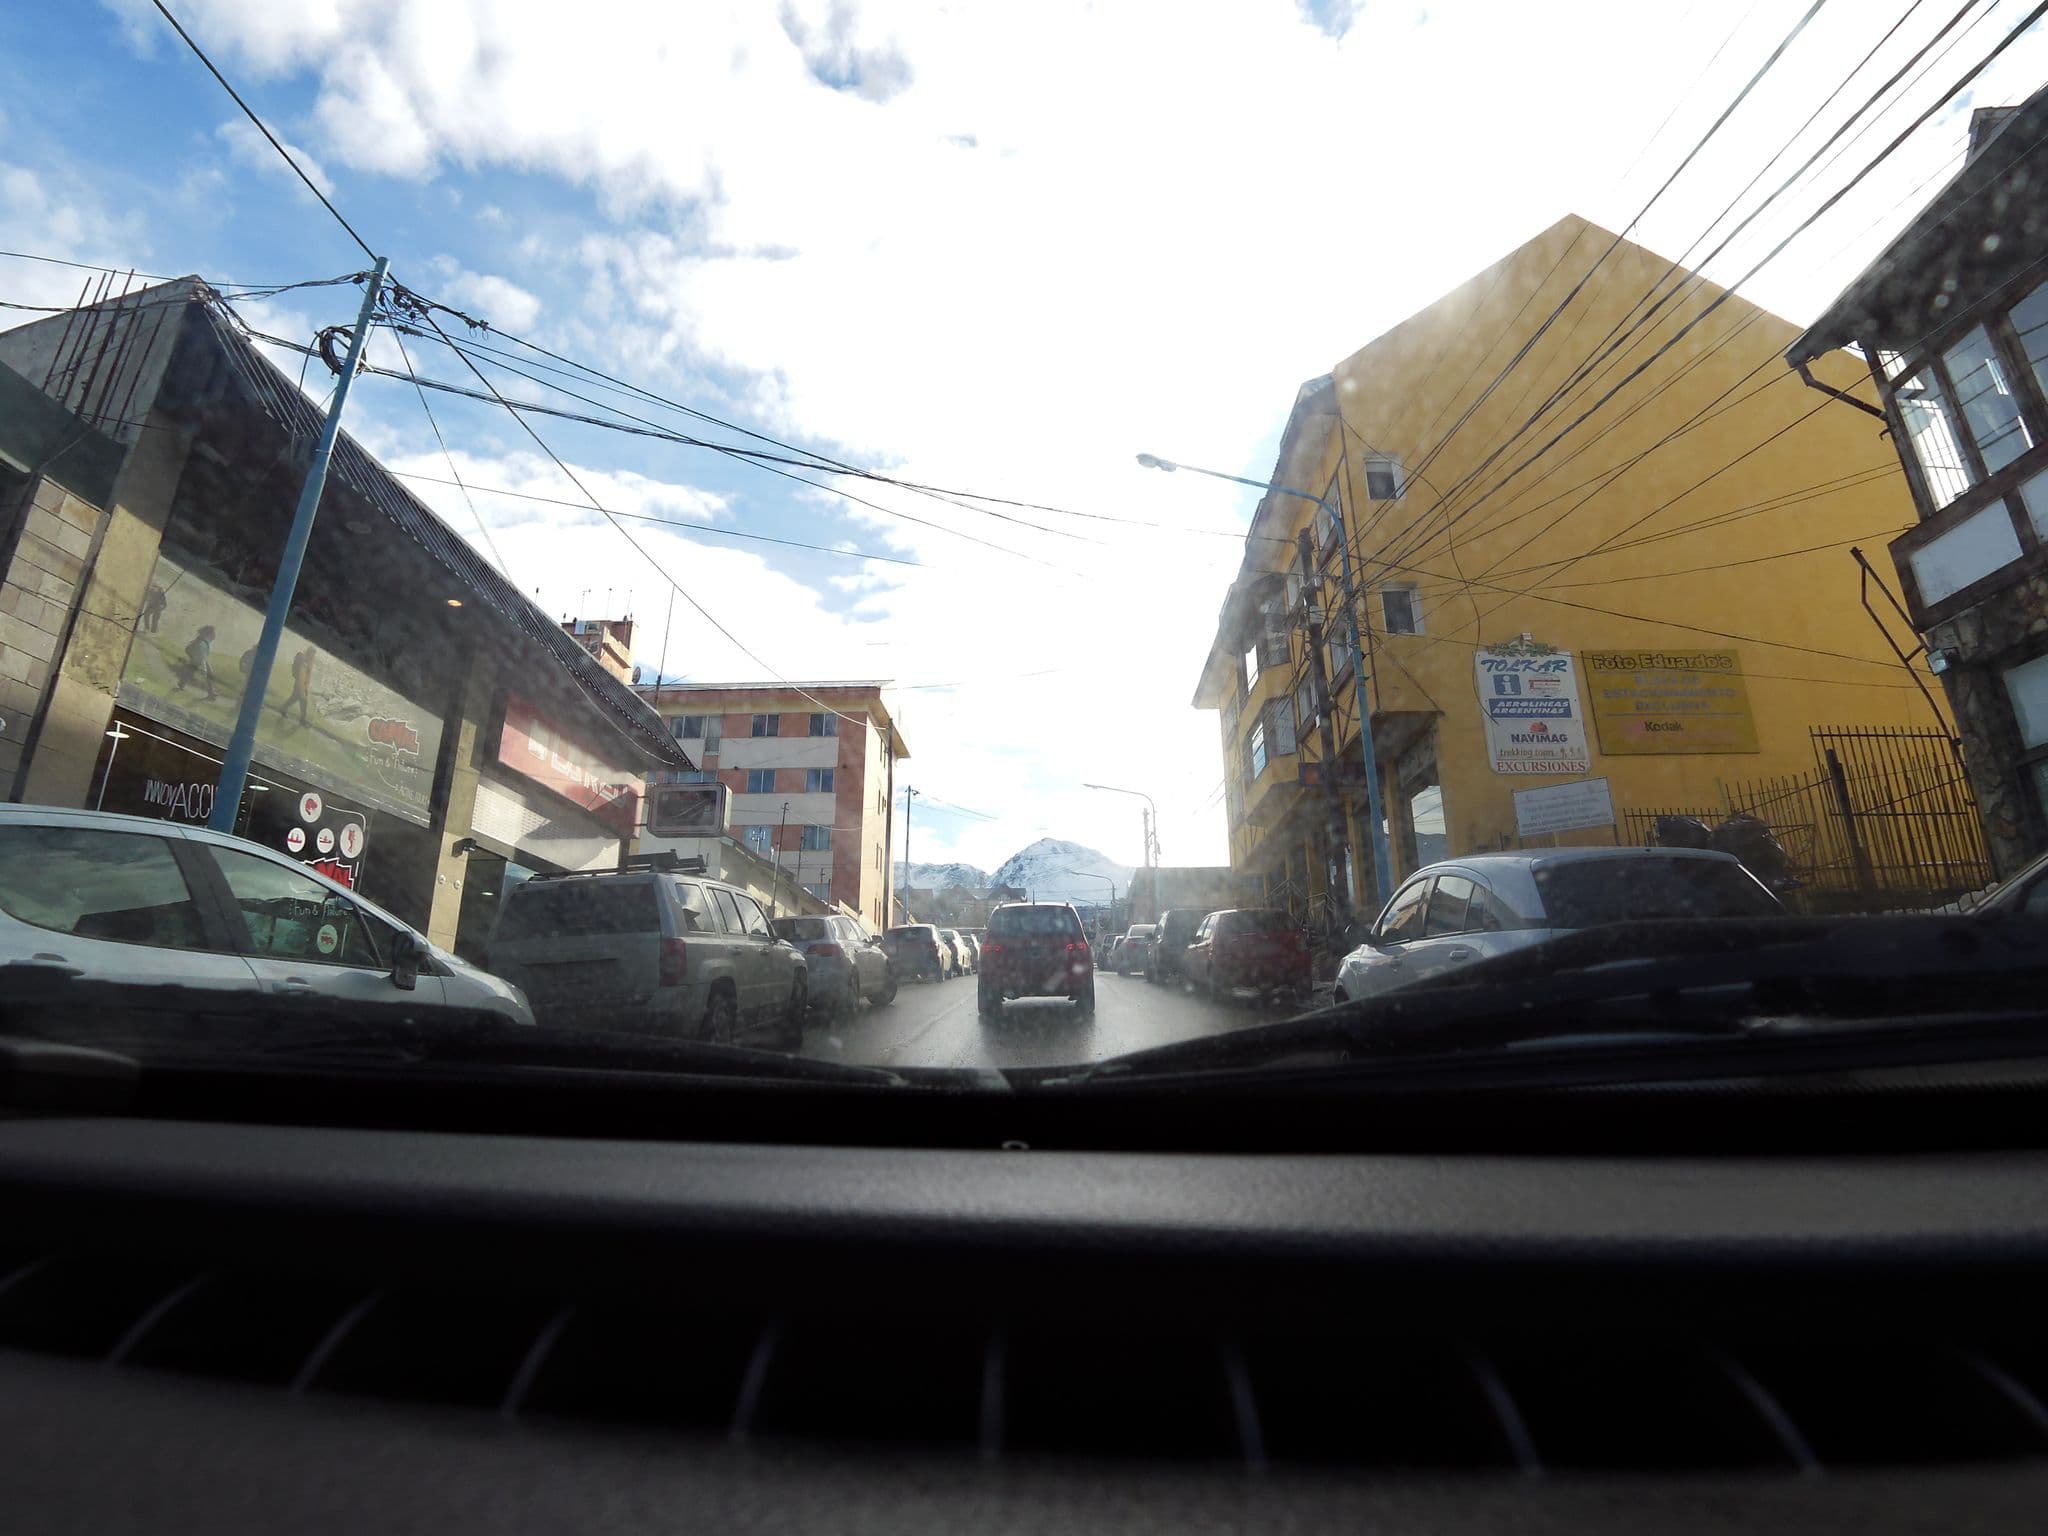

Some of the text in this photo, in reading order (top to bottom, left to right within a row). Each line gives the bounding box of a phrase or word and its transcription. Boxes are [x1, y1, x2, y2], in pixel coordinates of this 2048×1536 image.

[1480, 659, 1568, 673] TOLKAR
[1592, 653, 1733, 670] Foto Eduardo's
[1645, 721, 1684, 732] Kodak
[1511, 733, 1568, 743] NAVIMAG
[1496, 761, 1586, 772] EXCURSIONES
